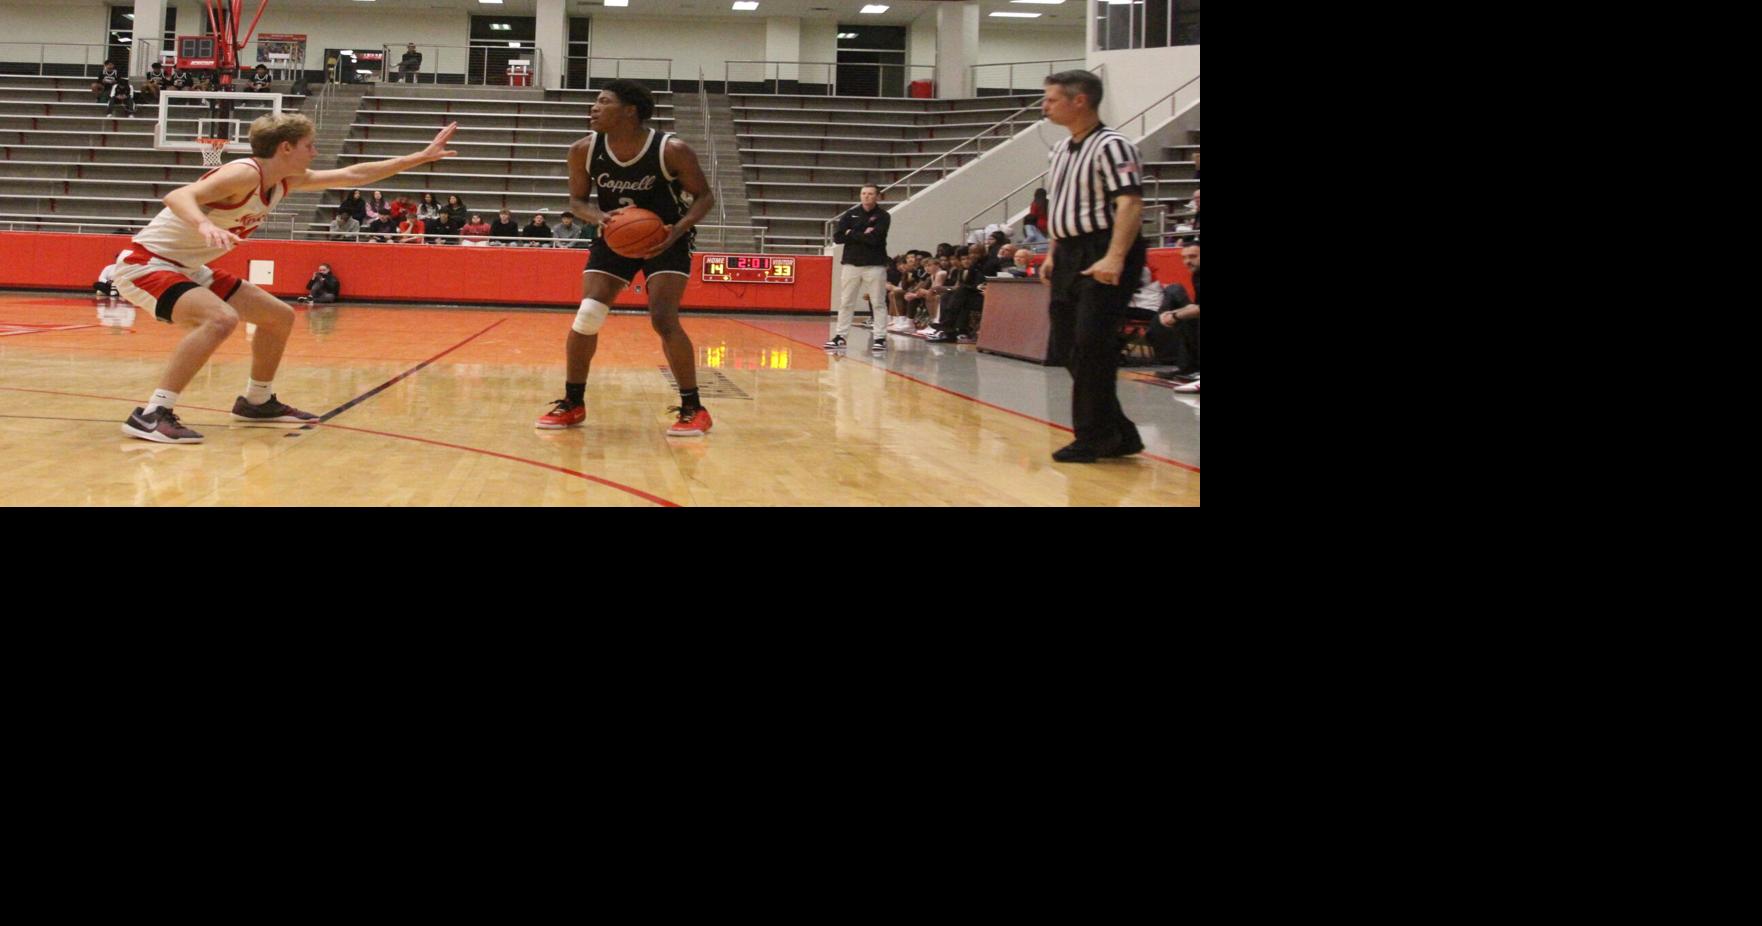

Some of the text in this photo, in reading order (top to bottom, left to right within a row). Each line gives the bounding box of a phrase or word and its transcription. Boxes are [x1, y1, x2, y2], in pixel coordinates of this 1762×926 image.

[597, 172, 656, 192] Coppell
[711, 263, 724, 274] 14
[738, 258, 769, 268] 2:01
[773, 265, 791, 276] 33
